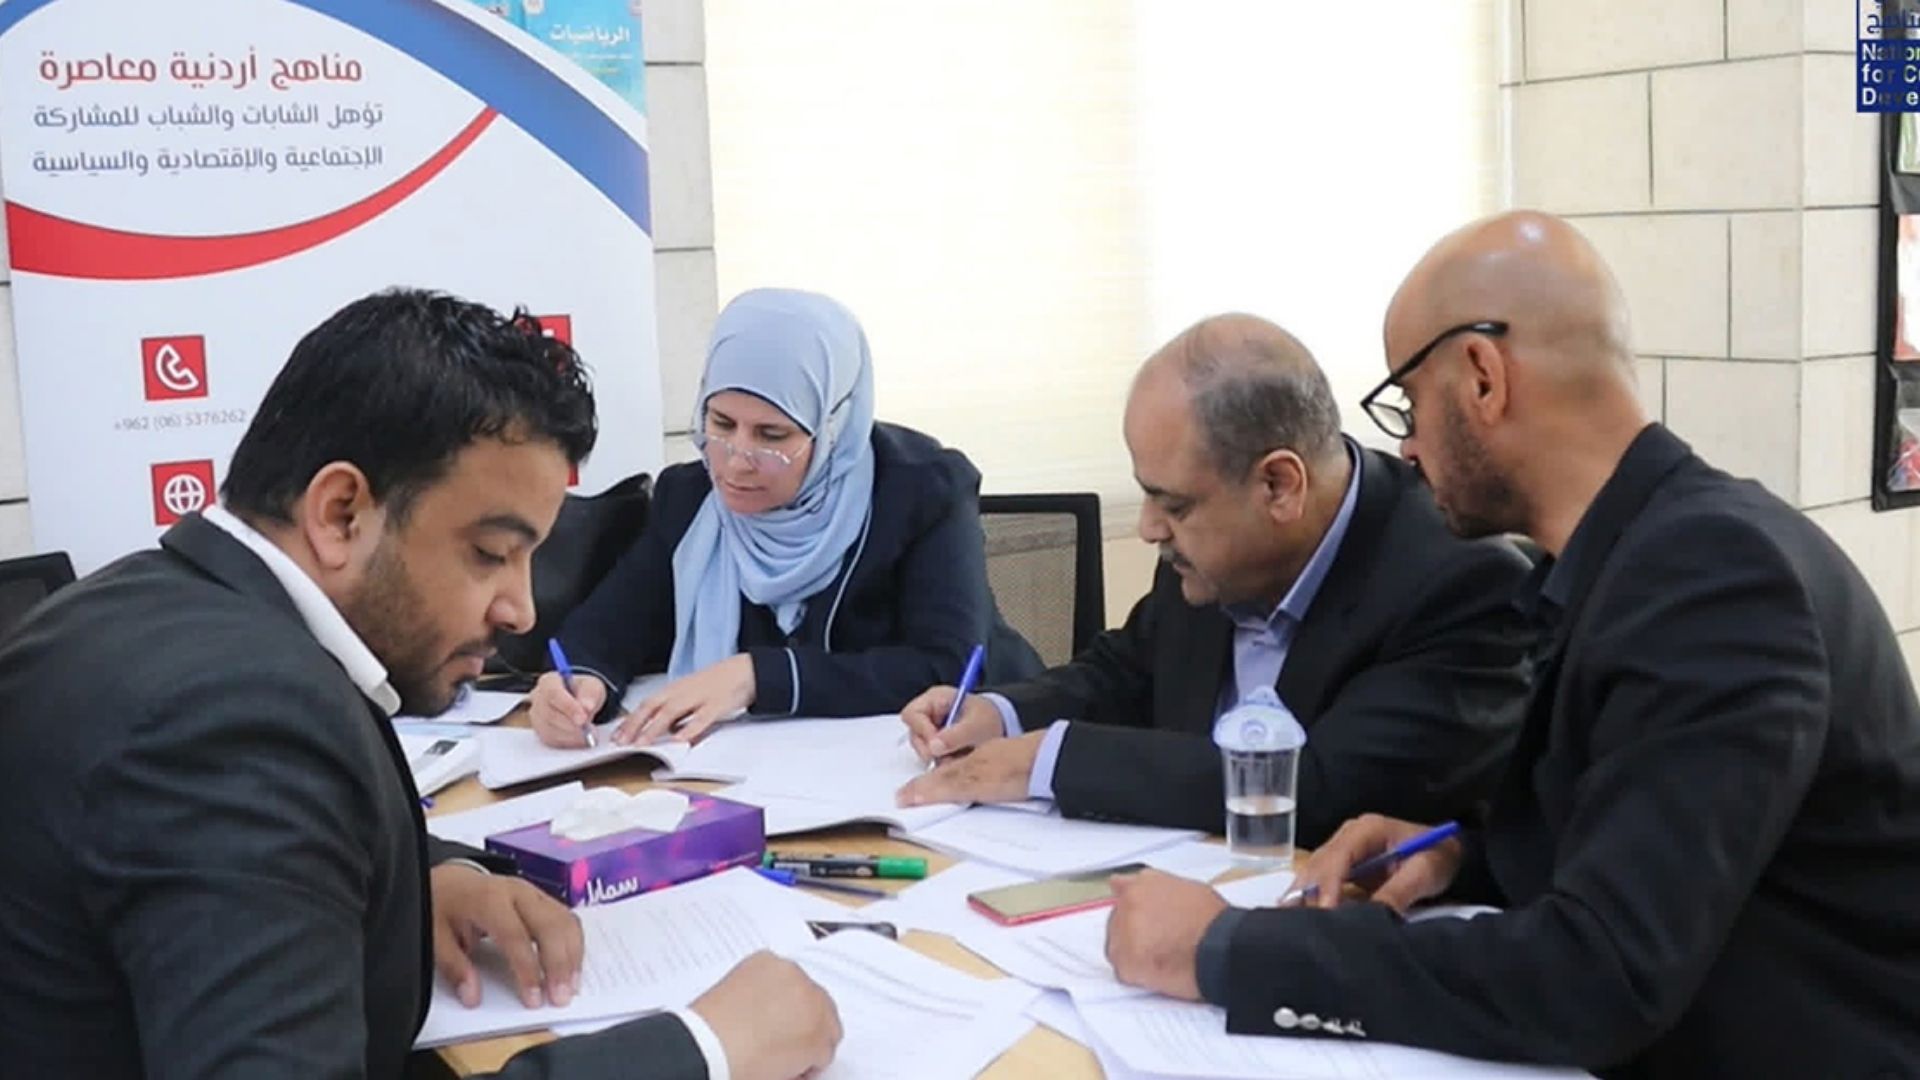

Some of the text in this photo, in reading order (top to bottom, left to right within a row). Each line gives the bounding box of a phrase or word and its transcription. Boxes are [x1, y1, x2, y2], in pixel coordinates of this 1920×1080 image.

[550, 24, 631, 47] الرياضيات
[39, 45, 362, 90] مناهج أردنية معاصرة
[33, 101, 384, 134] تؤهل الشابات والشباب للمشاركة
[32, 149, 150, 178] والسياسية
